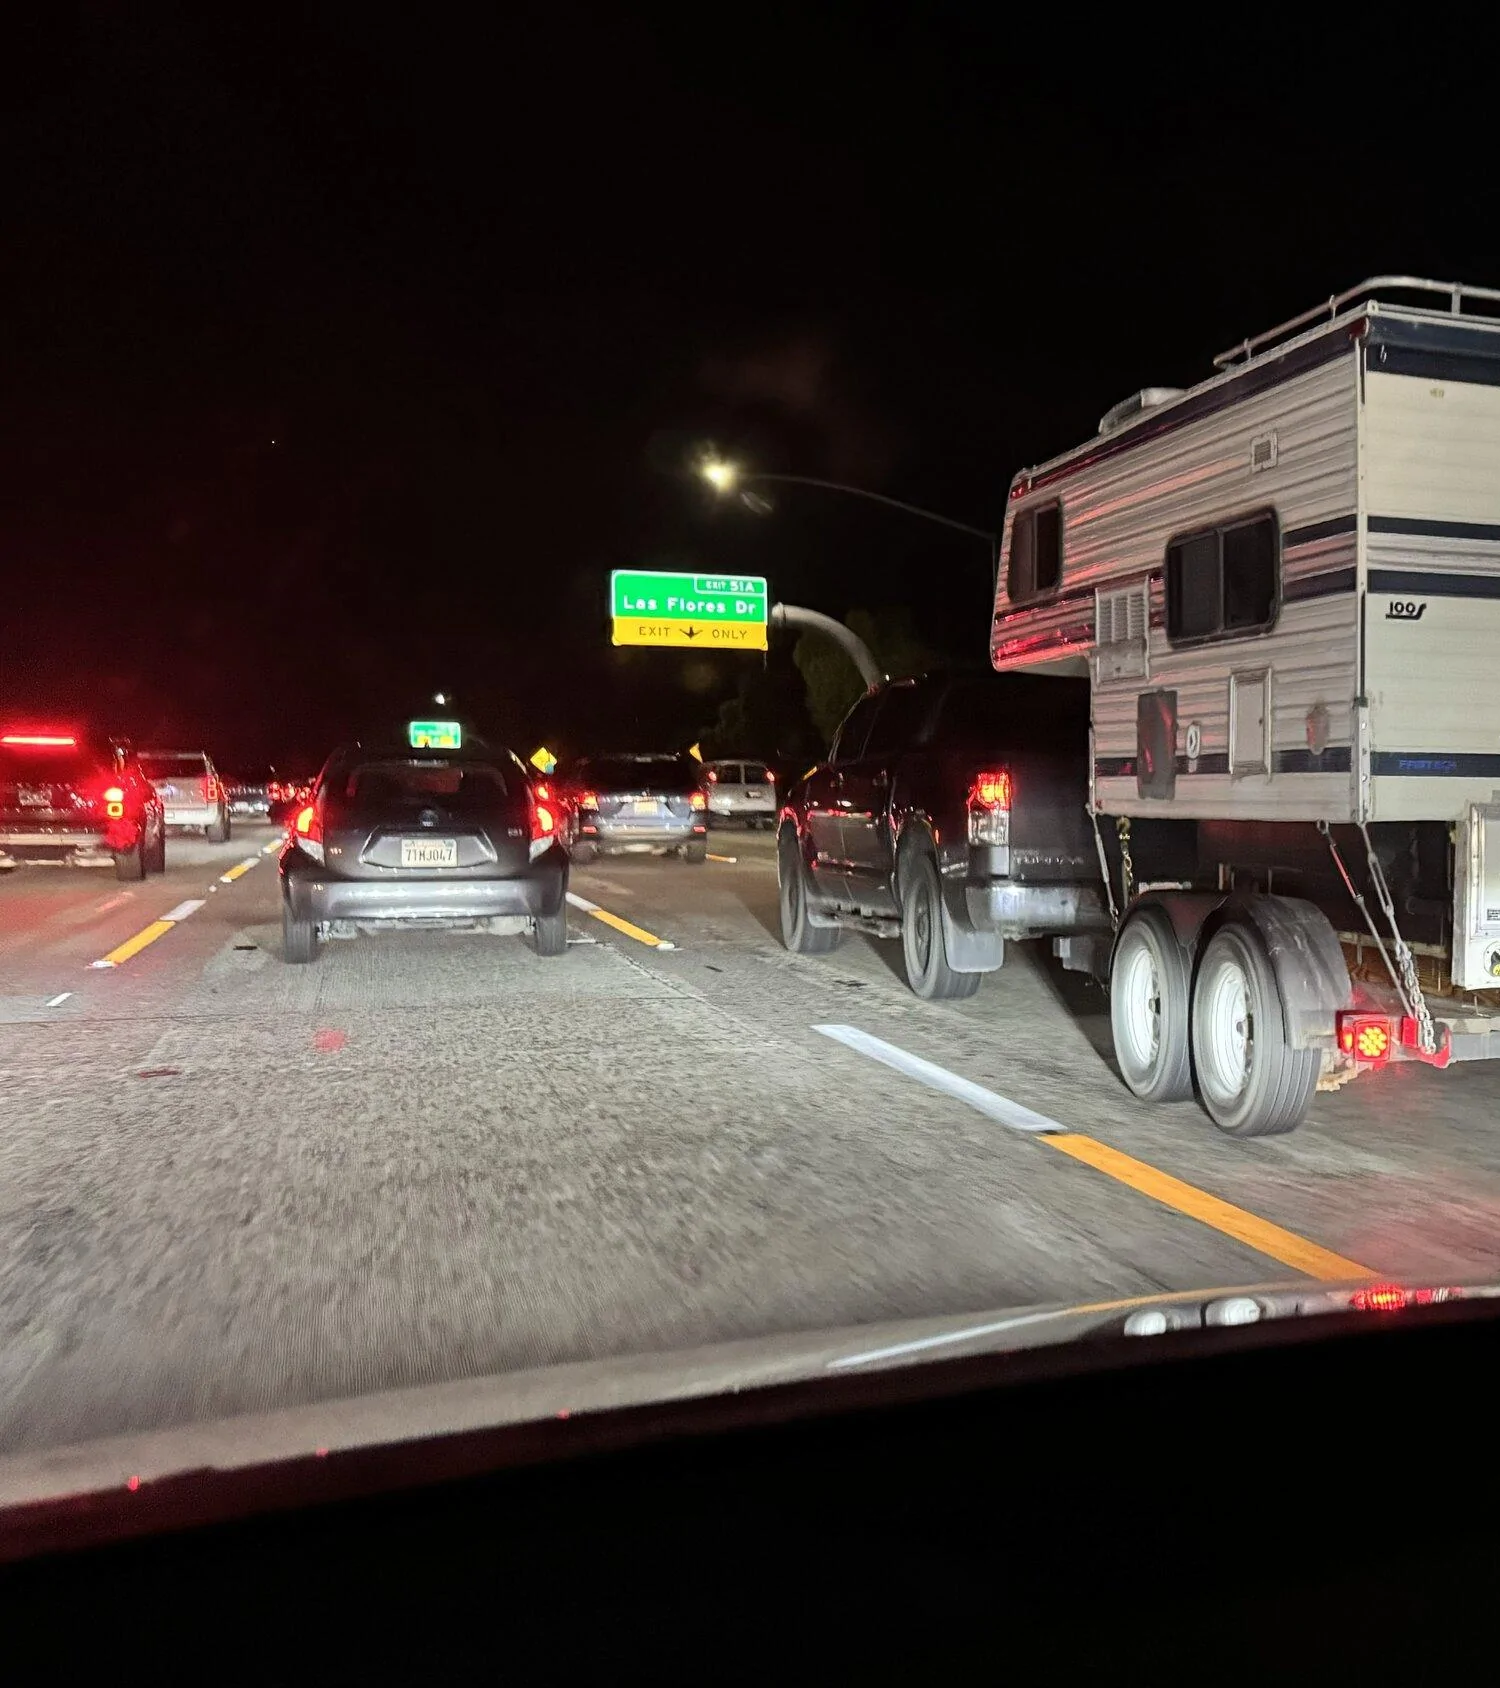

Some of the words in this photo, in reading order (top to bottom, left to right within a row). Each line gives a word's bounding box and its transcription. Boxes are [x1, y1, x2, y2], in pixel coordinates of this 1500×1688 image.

[705, 580, 726, 590] EXIT
[730, 580, 755, 592] 51A
[623, 595, 657, 610] Las
[667, 597, 726, 613] Flores
[735, 600, 756, 614] Dr
[638, 626, 671, 637] EXIT
[712, 628, 748, 640] ONLY
